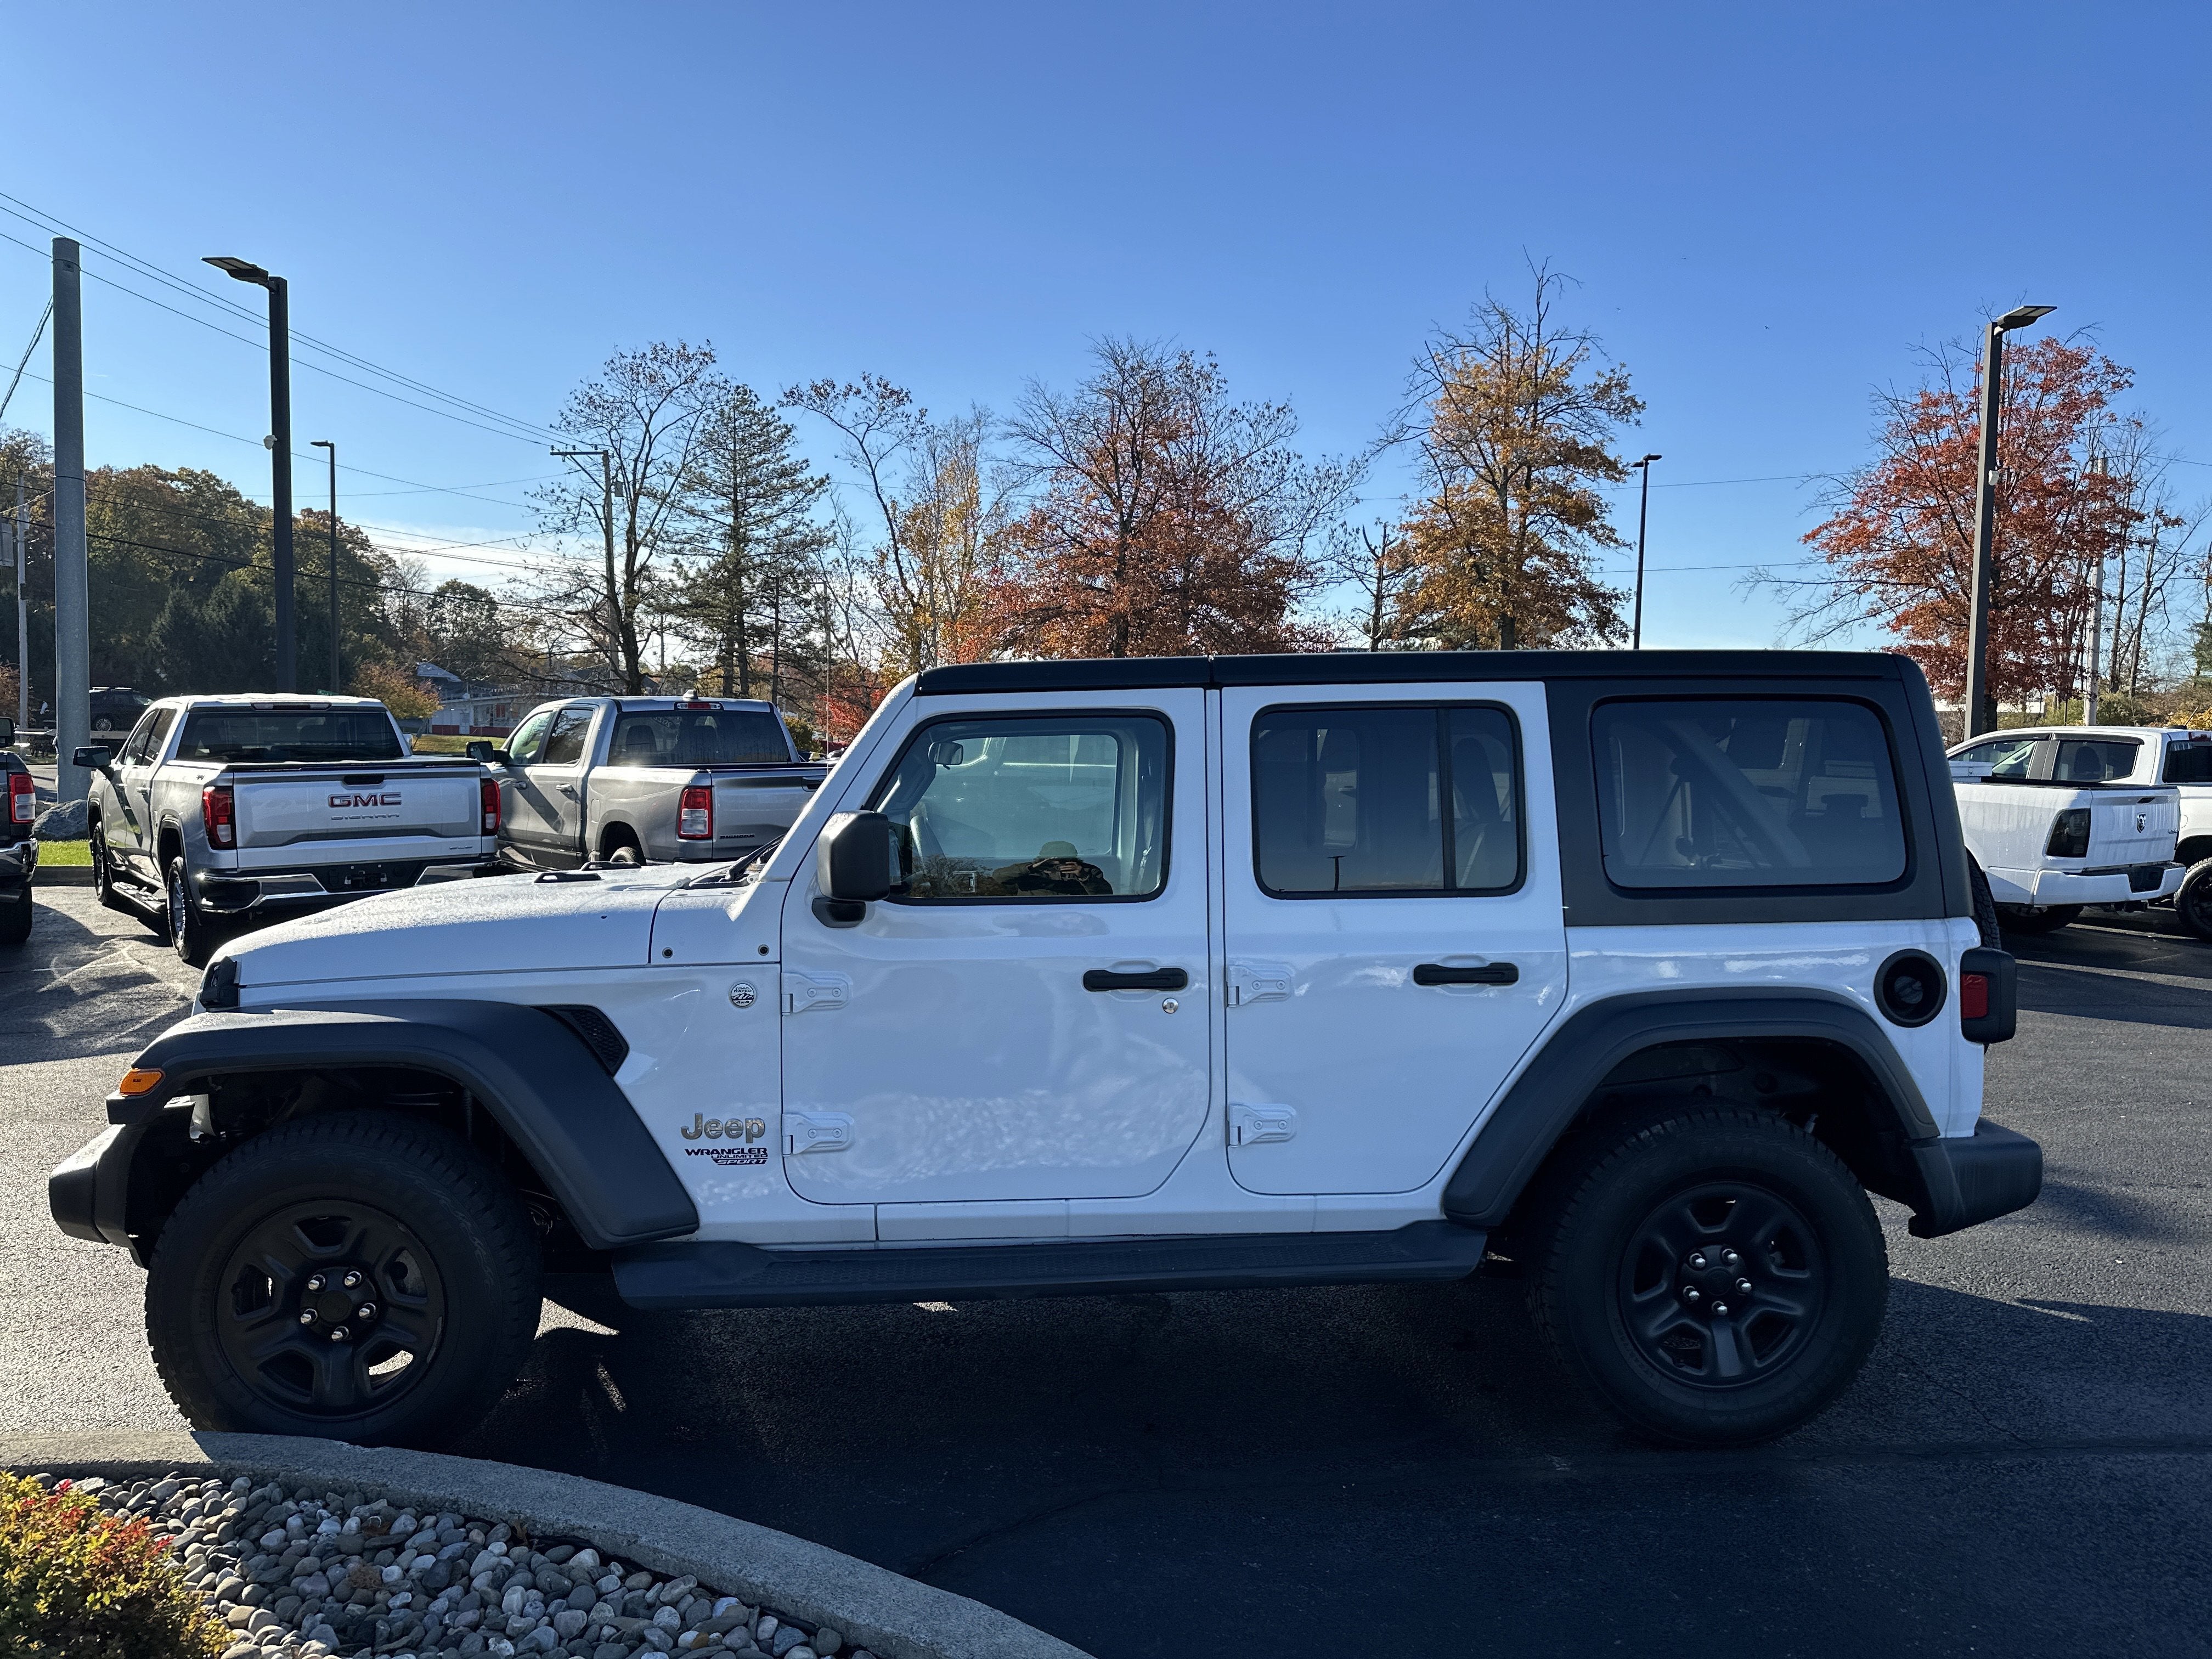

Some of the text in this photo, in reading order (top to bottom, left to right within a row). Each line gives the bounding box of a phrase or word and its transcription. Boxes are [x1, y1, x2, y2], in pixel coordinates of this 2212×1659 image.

[328, 792, 402, 808] GMC
[680, 1112, 765, 1144] Jeep
[684, 1147, 768, 1156] WRANGLER
